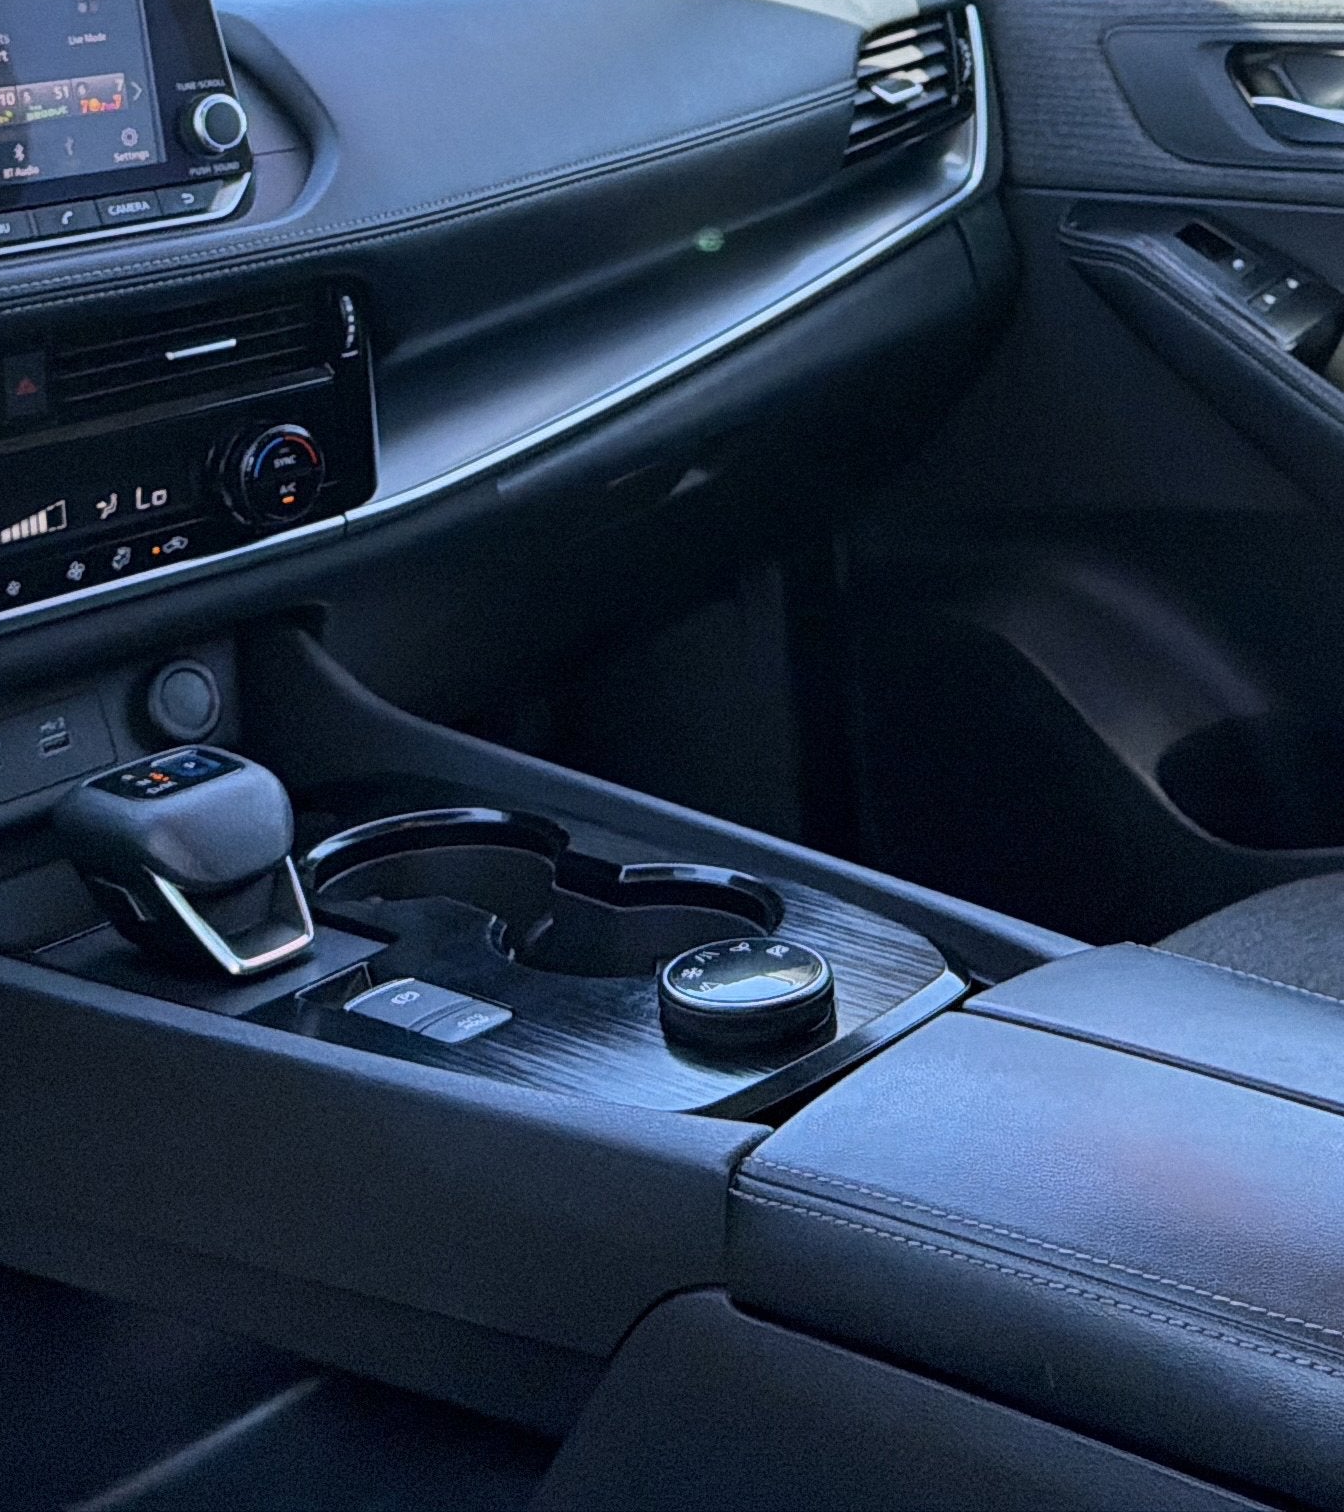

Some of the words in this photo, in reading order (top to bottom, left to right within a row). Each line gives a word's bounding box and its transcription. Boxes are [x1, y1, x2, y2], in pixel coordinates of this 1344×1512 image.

[0, 92, 16, 106] 10
[54, 85, 69, 99] 51
[113, 150, 150, 164] Settings
[15, 165, 40, 177] Audio
[108, 200, 151, 216] CAMERA
[273, 453, 297, 469] SYNC
[135, 486, 167, 510] Lo
